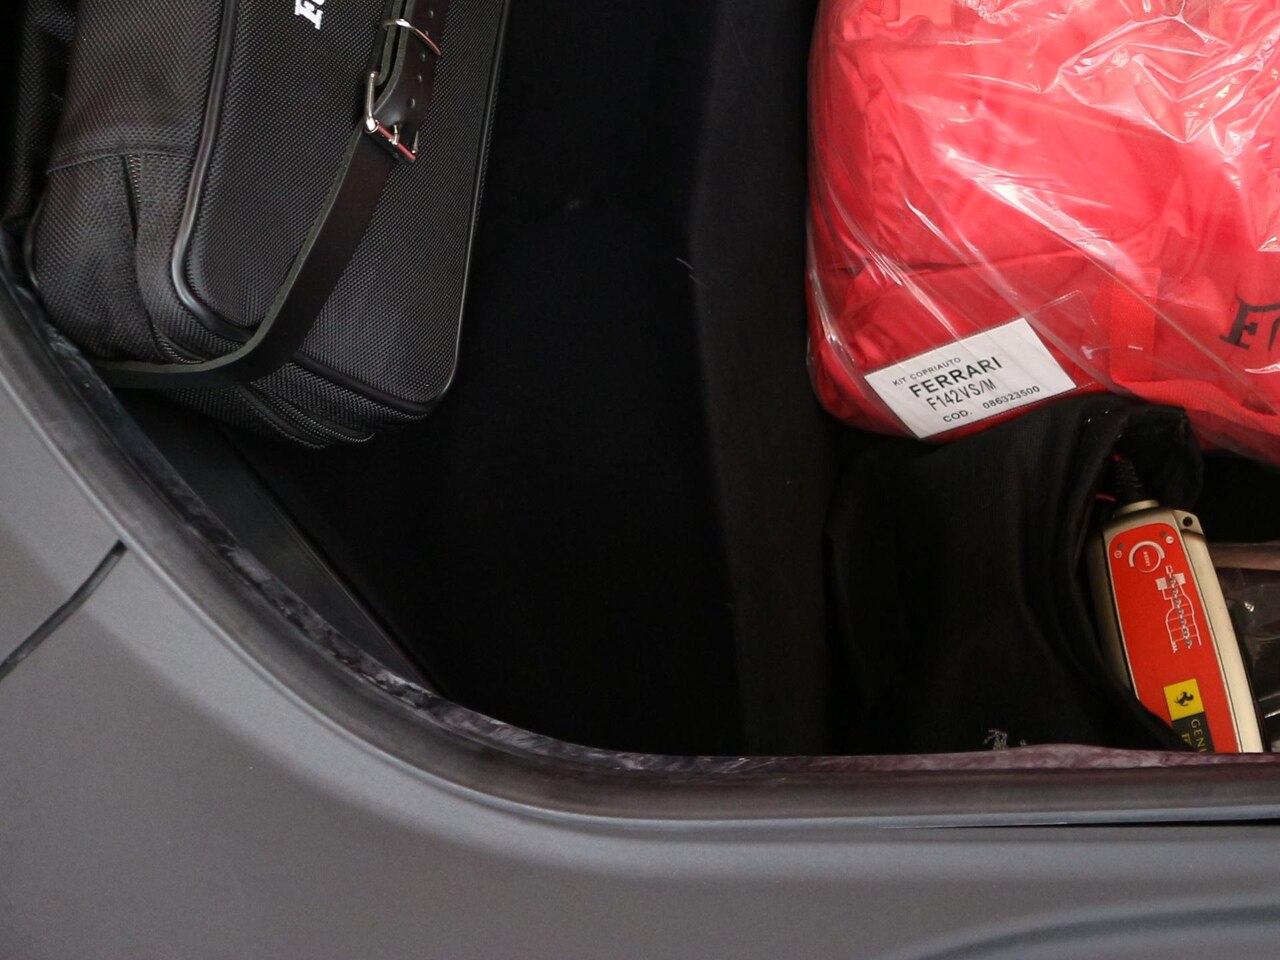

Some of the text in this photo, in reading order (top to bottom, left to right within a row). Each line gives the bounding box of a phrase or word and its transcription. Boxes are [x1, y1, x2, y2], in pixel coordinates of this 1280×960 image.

[892, 357, 962, 386] KIT COPRIAUTO
[908, 356, 1003, 398] FERRARI
[926, 378, 997, 412] F142VS/M
[942, 385, 1041, 423] COD. 086323500
